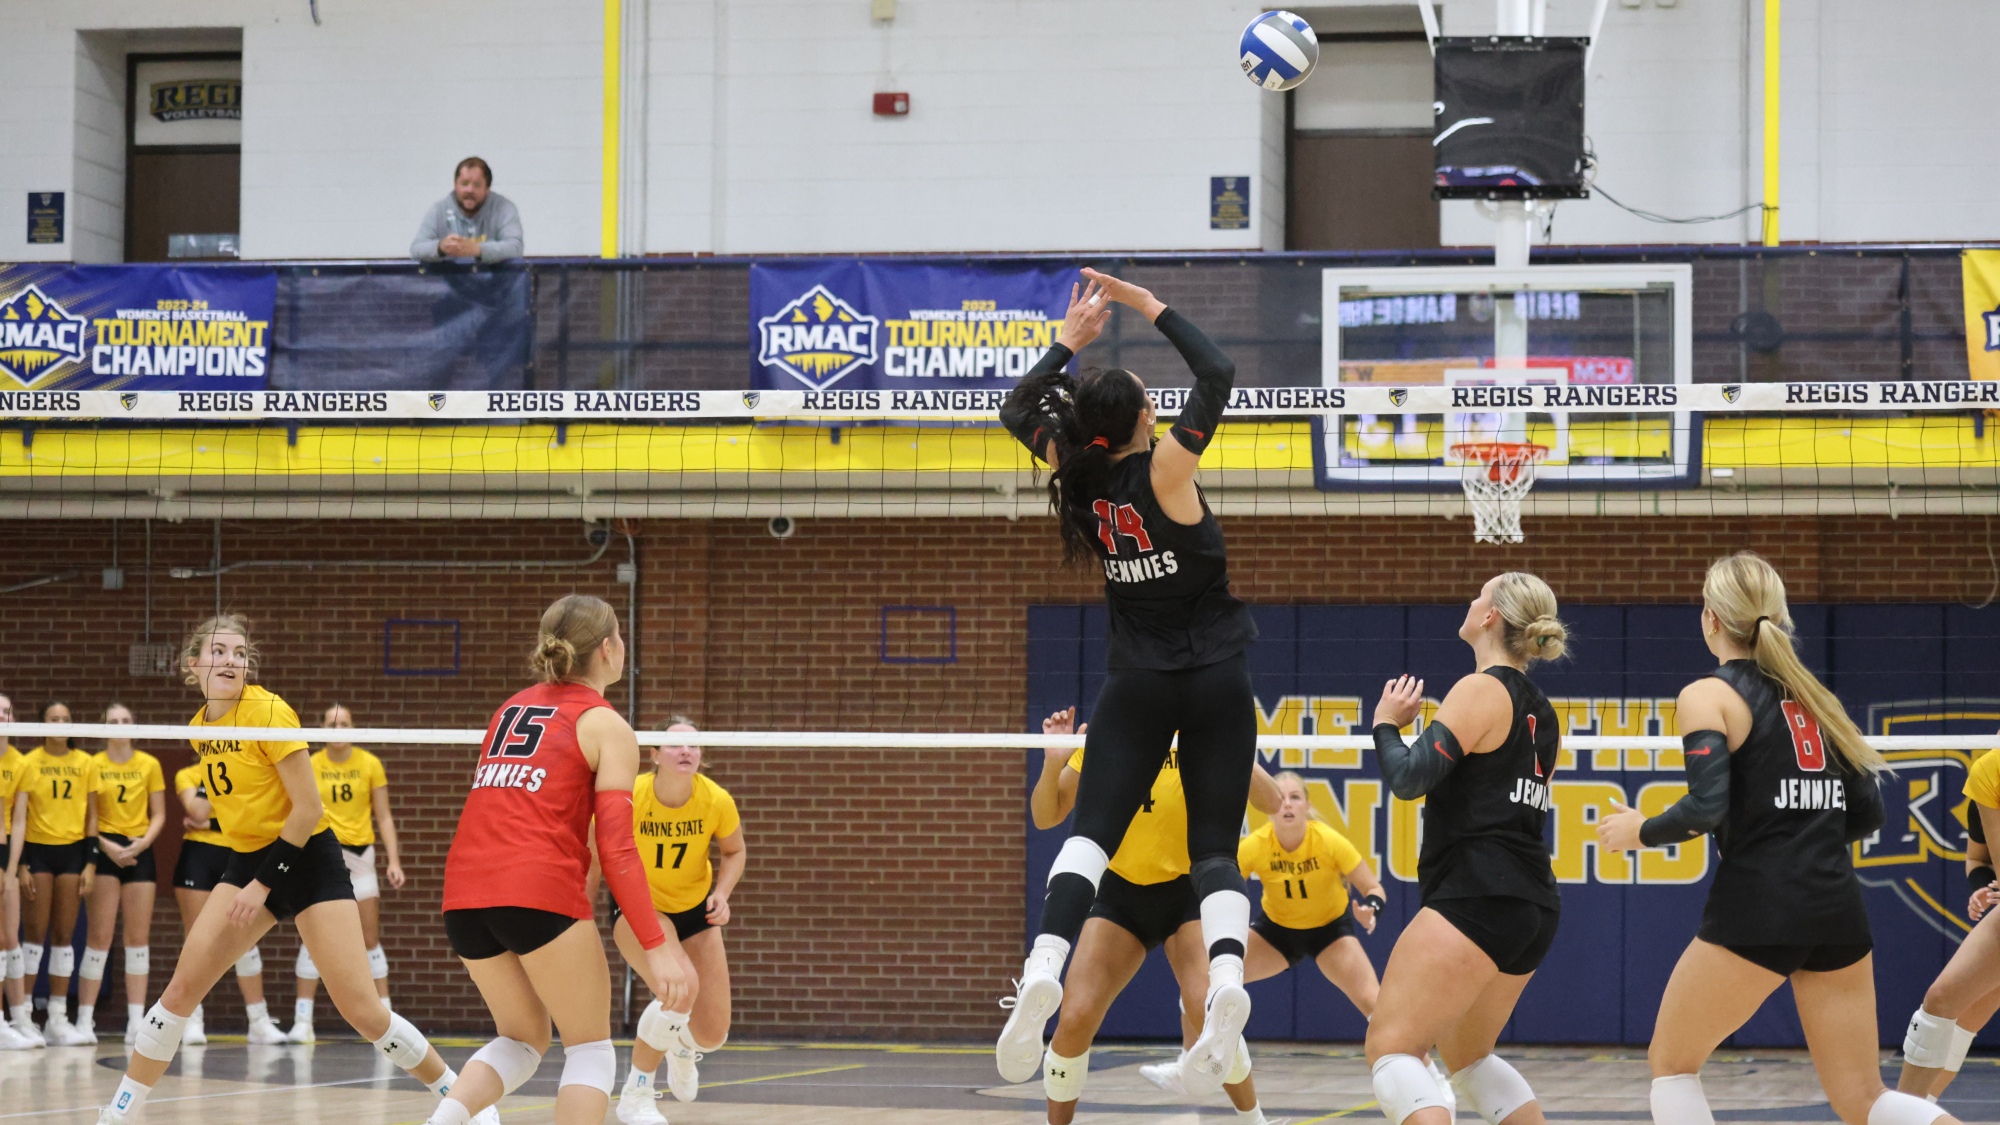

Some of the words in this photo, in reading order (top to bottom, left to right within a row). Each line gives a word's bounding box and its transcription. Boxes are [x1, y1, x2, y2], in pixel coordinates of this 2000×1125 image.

[153, 83, 240, 110] REGI
[162, 109, 240, 121] VOLLEYBAL
[116, 309, 170, 321] WOMEN'S
[172, 310, 248, 322] BASKETBALL
[157, 300, 208, 311] 2023-24
[909, 310, 966, 321] WOMEN'S
[967, 310, 1047, 322] BASKETBALL
[962, 300, 996, 311] 2023
[0, 323, 77, 358] MAC
[93, 319, 268, 347] TOURNAMENT
[769, 325, 869, 356] RMAC
[885, 320, 1066, 347] TOURNAMENT
[92, 345, 266, 377] CHAMPIONS
[884, 347, 1050, 377] CHAMPION
[178, 392, 253, 411] REGIS
[263, 392, 387, 411] RANGERS
[487, 392, 564, 411] REGIS
[574, 392, 701, 411] RANGERS
[802, 391, 880, 410] REGIS
[1147, 390, 1188, 409] EGI
[1227, 388, 1345, 409] ANGERS
[1451, 386, 1533, 407] REGIS
[1543, 385, 1677, 406] RANGERS
[1785, 383, 1868, 403] REGIS
[1093, 499, 1153, 555] 14
[487, 705, 558, 759] 15
[1253, 696, 1362, 769] ME
[1781, 700, 1826, 772] 8
[207, 761, 233, 796] 13
[472, 763, 547, 793] ENNIES
[52, 779, 73, 799] 12
[117, 784, 127, 803] 2
[332, 783, 353, 803] 18
[640, 820, 673, 837] WAYNE
[675, 819, 704, 837] STATE
[655, 843, 688, 869] 17
[1284, 879, 1308, 898] 11
